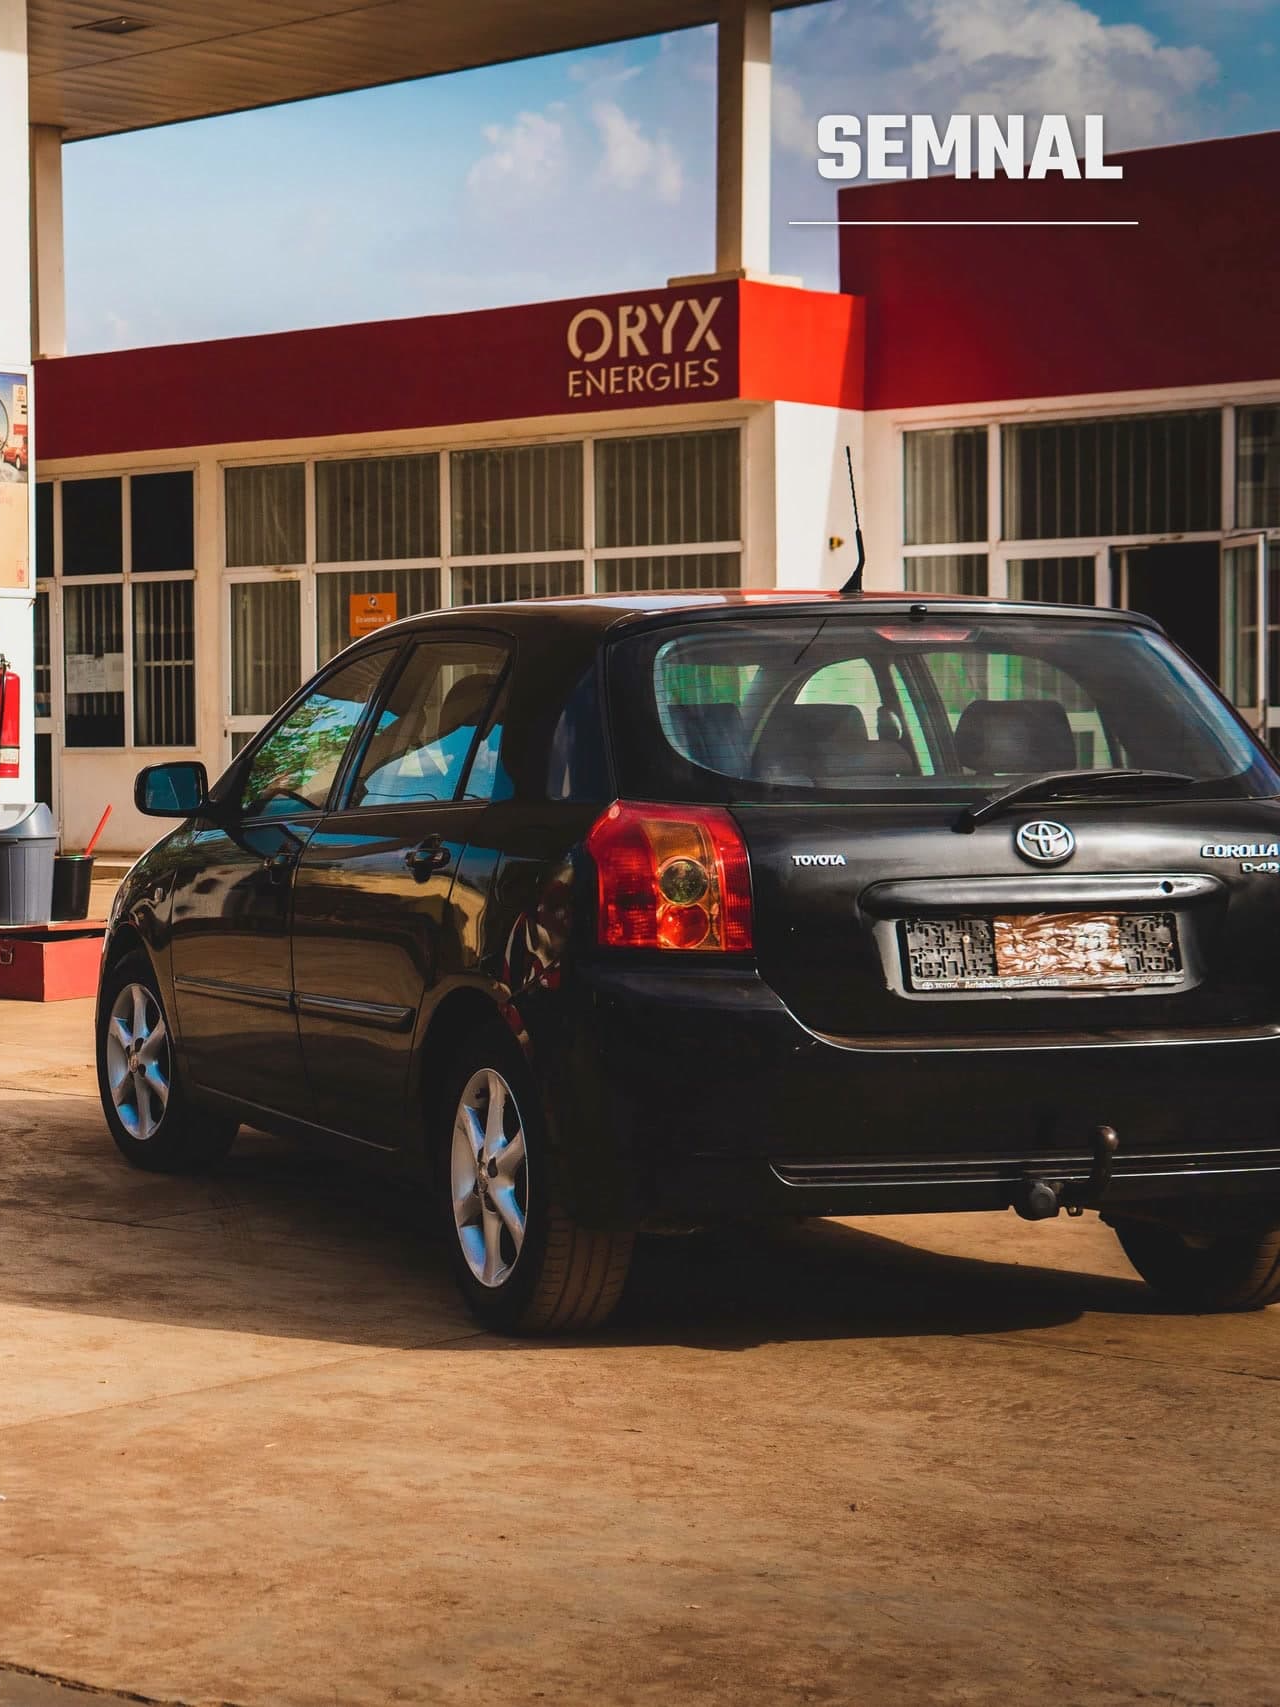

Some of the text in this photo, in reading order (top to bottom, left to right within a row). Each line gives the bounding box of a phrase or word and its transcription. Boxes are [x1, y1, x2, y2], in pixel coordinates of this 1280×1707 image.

[567, 297, 722, 362] ORYX
[568, 358, 720, 398] ENERGIES
[1201, 844, 1279, 858] COROLLA
[791, 855, 846, 866] TOYOTA
[1241, 863, 1279, 874] D-4D
